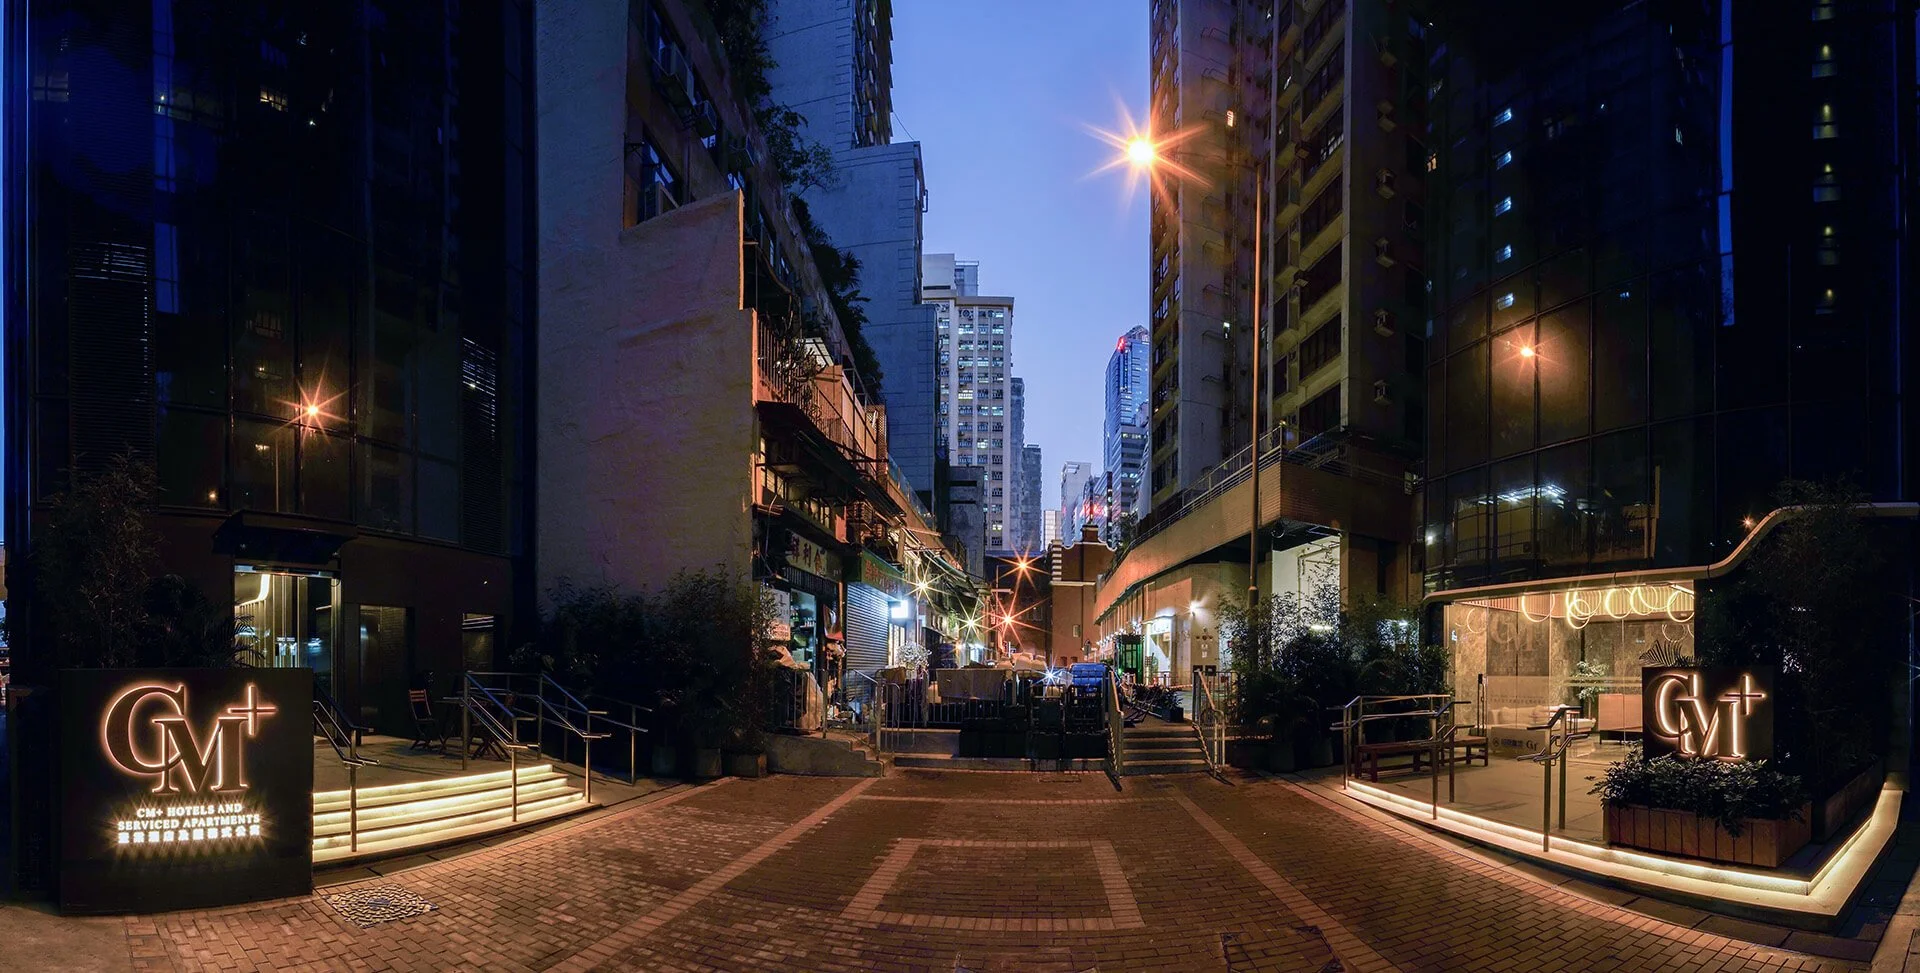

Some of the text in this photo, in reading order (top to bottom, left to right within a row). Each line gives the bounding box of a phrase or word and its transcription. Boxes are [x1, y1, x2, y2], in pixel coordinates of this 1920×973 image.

[136, 803, 243, 818] CM+ HOTELS AND
[118, 814, 260, 831] SERVICED APARTMENTS
